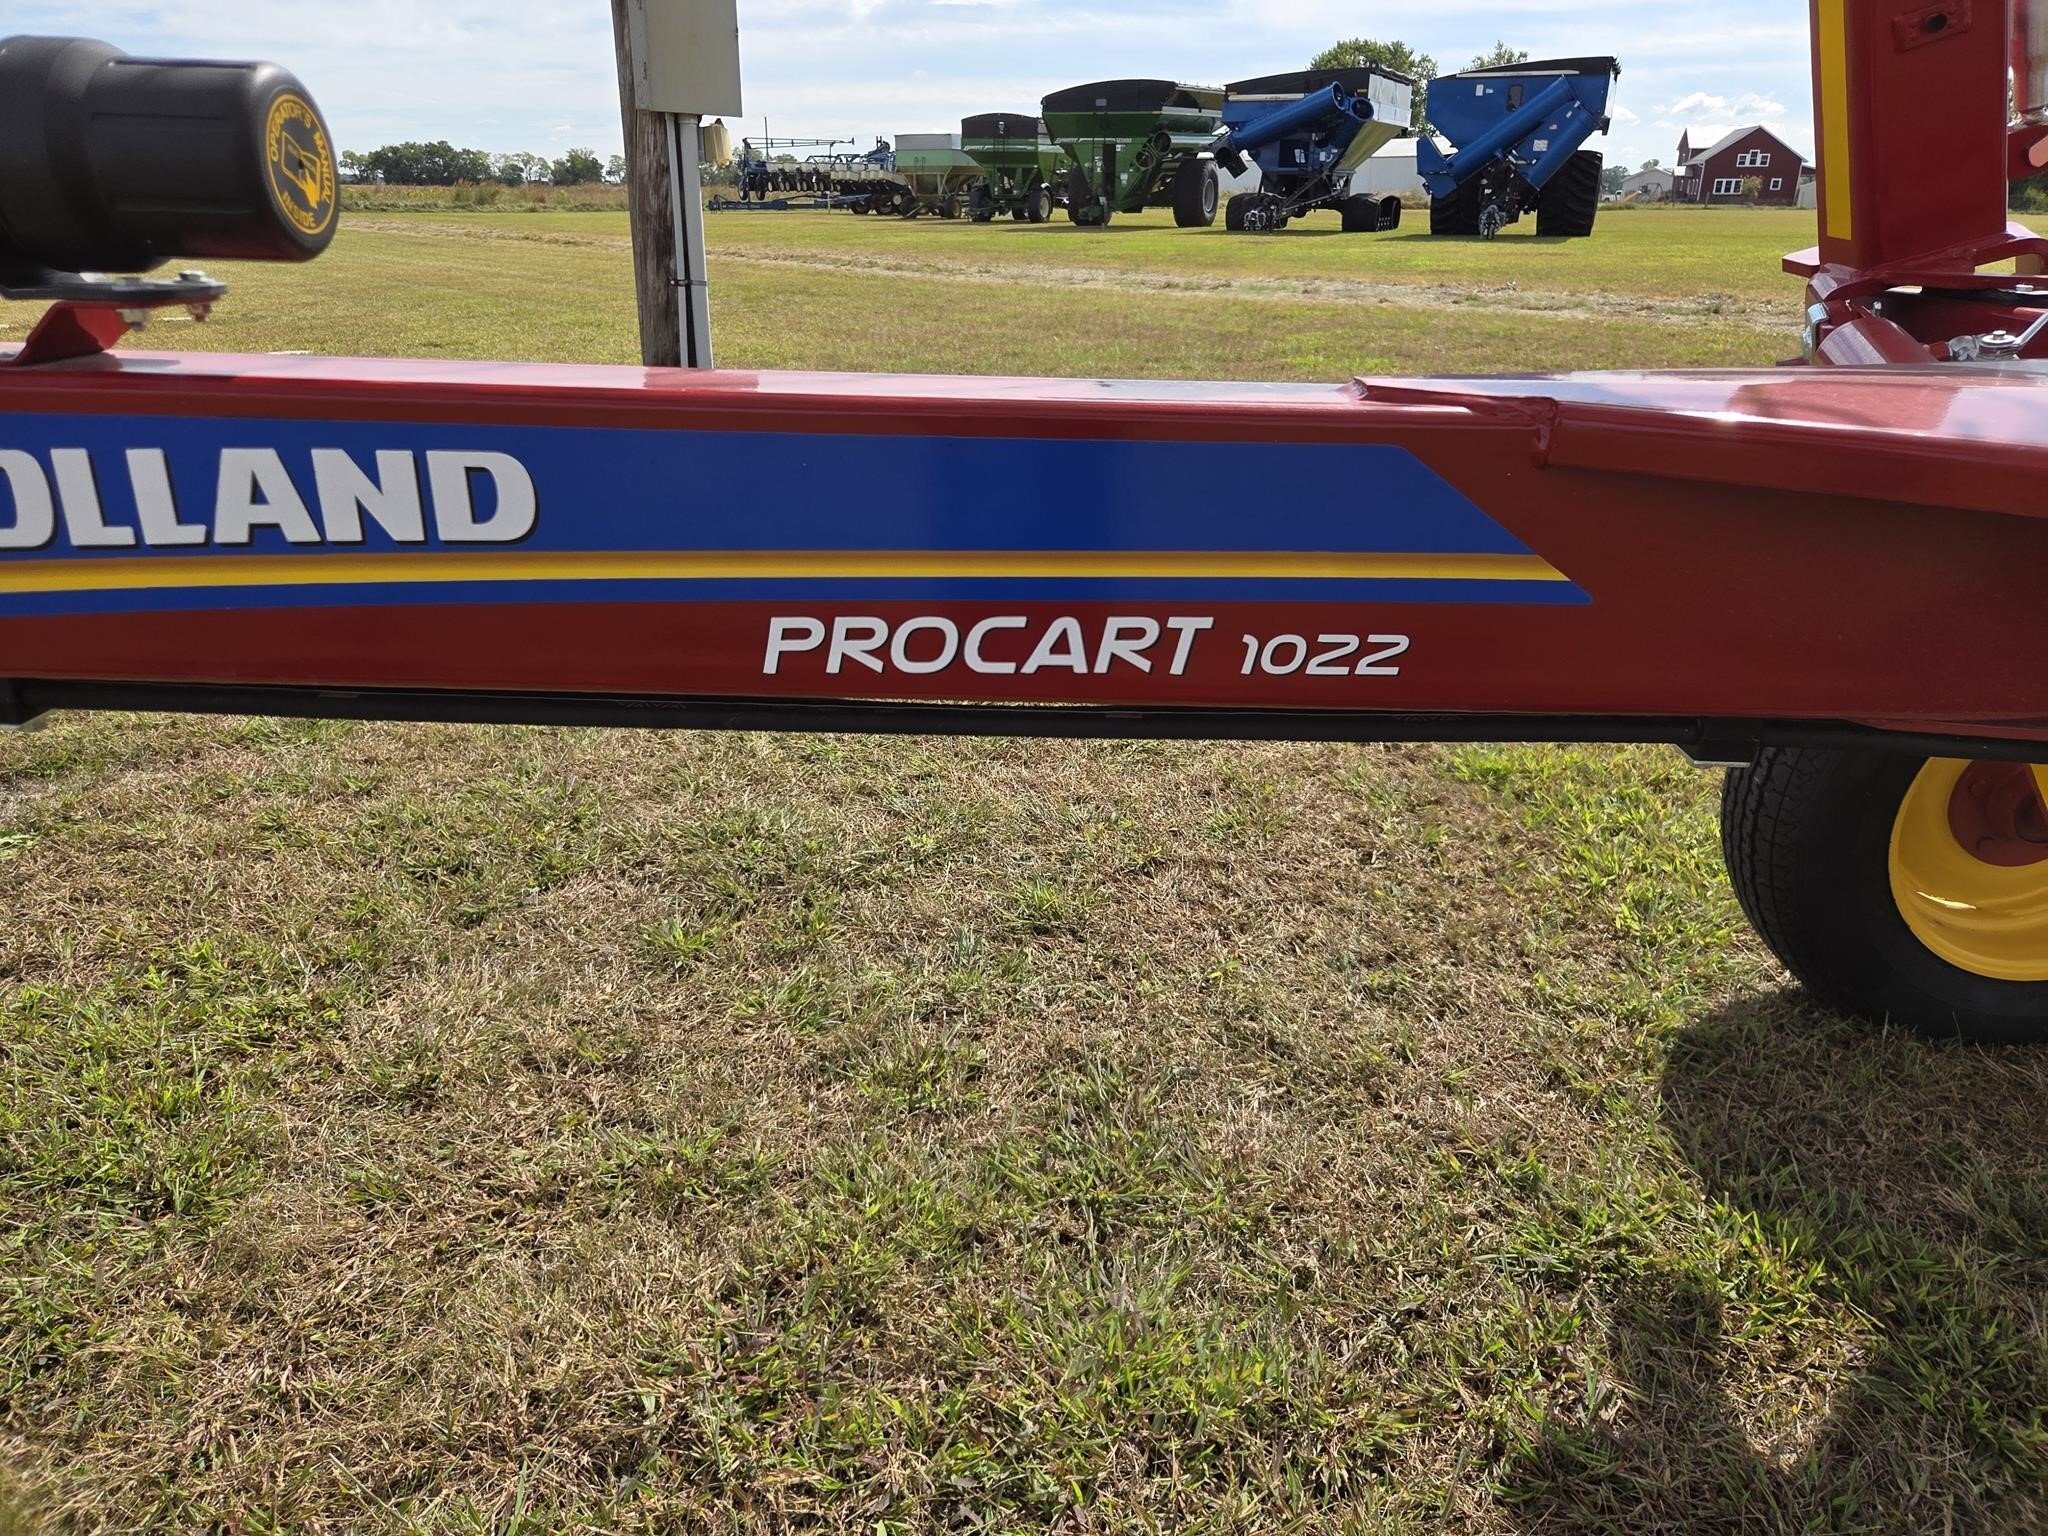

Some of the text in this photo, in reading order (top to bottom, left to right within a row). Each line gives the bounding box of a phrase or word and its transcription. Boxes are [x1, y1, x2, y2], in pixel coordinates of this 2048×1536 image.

[270, 103, 312, 162] OPERATOR'S
[314, 131, 332, 204] MANUAL
[283, 190, 317, 227] INSIDE
[763, 616, 1410, 675] PROCART 1022
